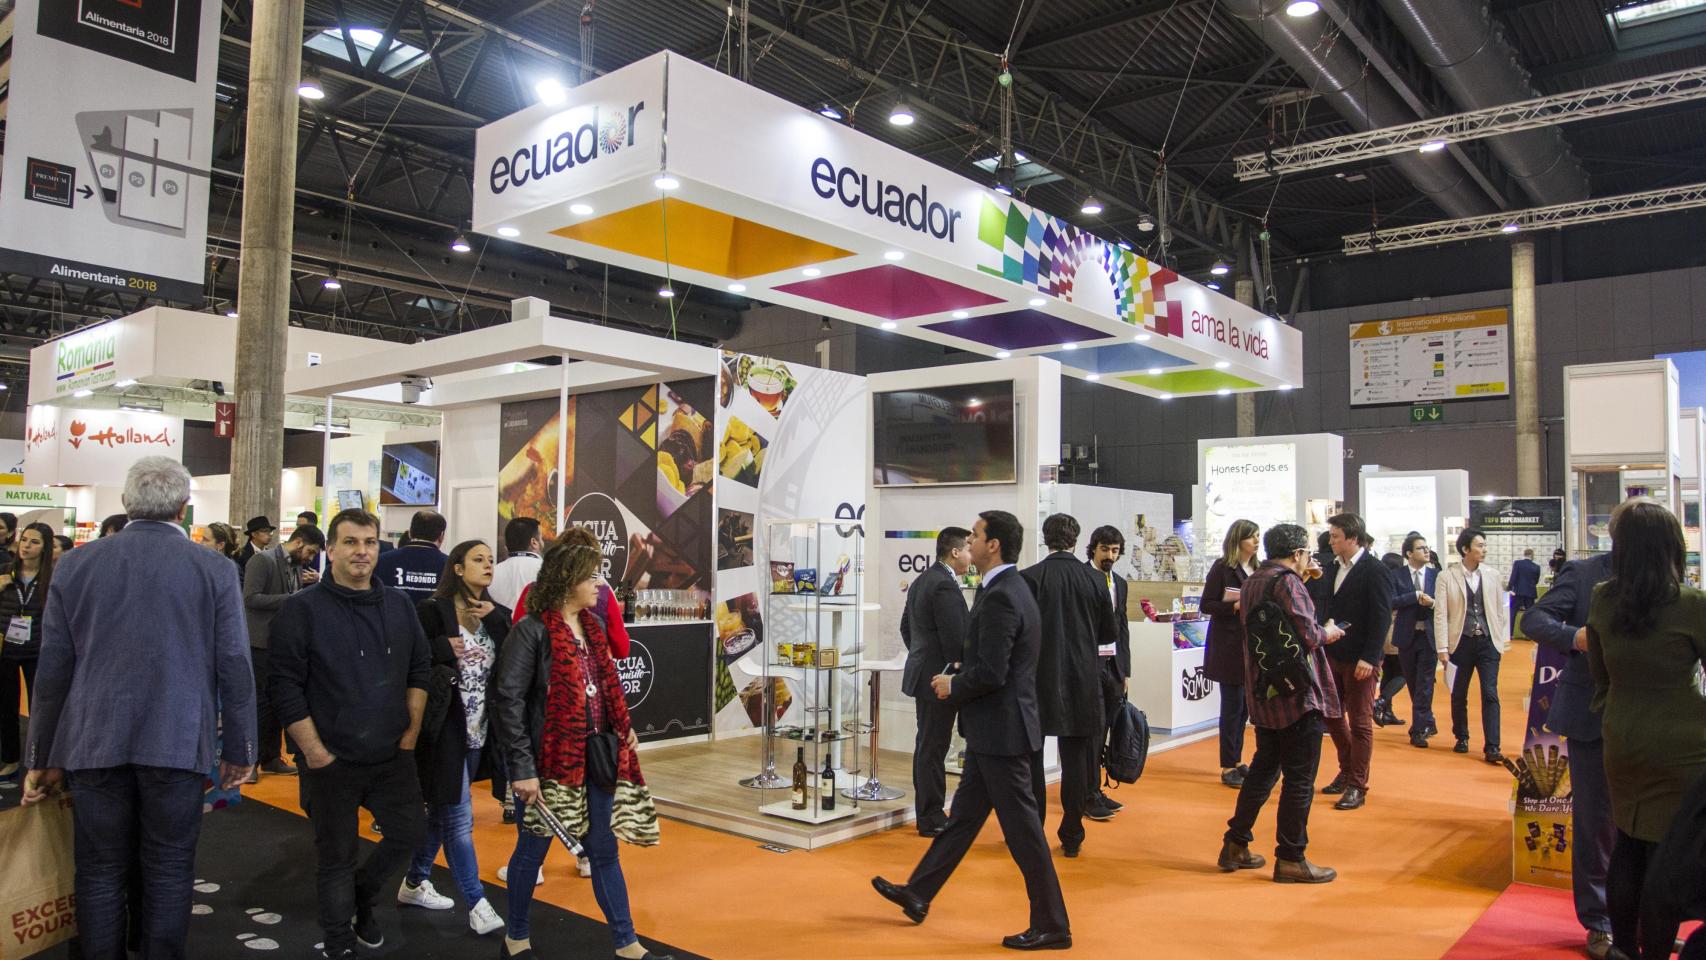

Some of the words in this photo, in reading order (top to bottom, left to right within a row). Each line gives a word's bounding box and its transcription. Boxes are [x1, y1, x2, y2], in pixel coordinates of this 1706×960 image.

[85, 11, 146, 38] Alimentaria
[146, 31, 169, 46] 2018
[489, 99, 645, 194] ecuador
[810, 157, 962, 243] ecuador
[50, 263, 126, 287] Alimentaria
[128, 277, 157, 292] 2018
[1191, 309, 1226, 342] ama
[1228, 317, 1241, 349] la
[1243, 330, 1269, 360] vida
[1211, 463, 1289, 477] HonestFoods.es
[5, 490, 53, 501] NATURAL
[405, 575, 437, 584] REDONDO
[13, 913, 77, 945] YOUR
